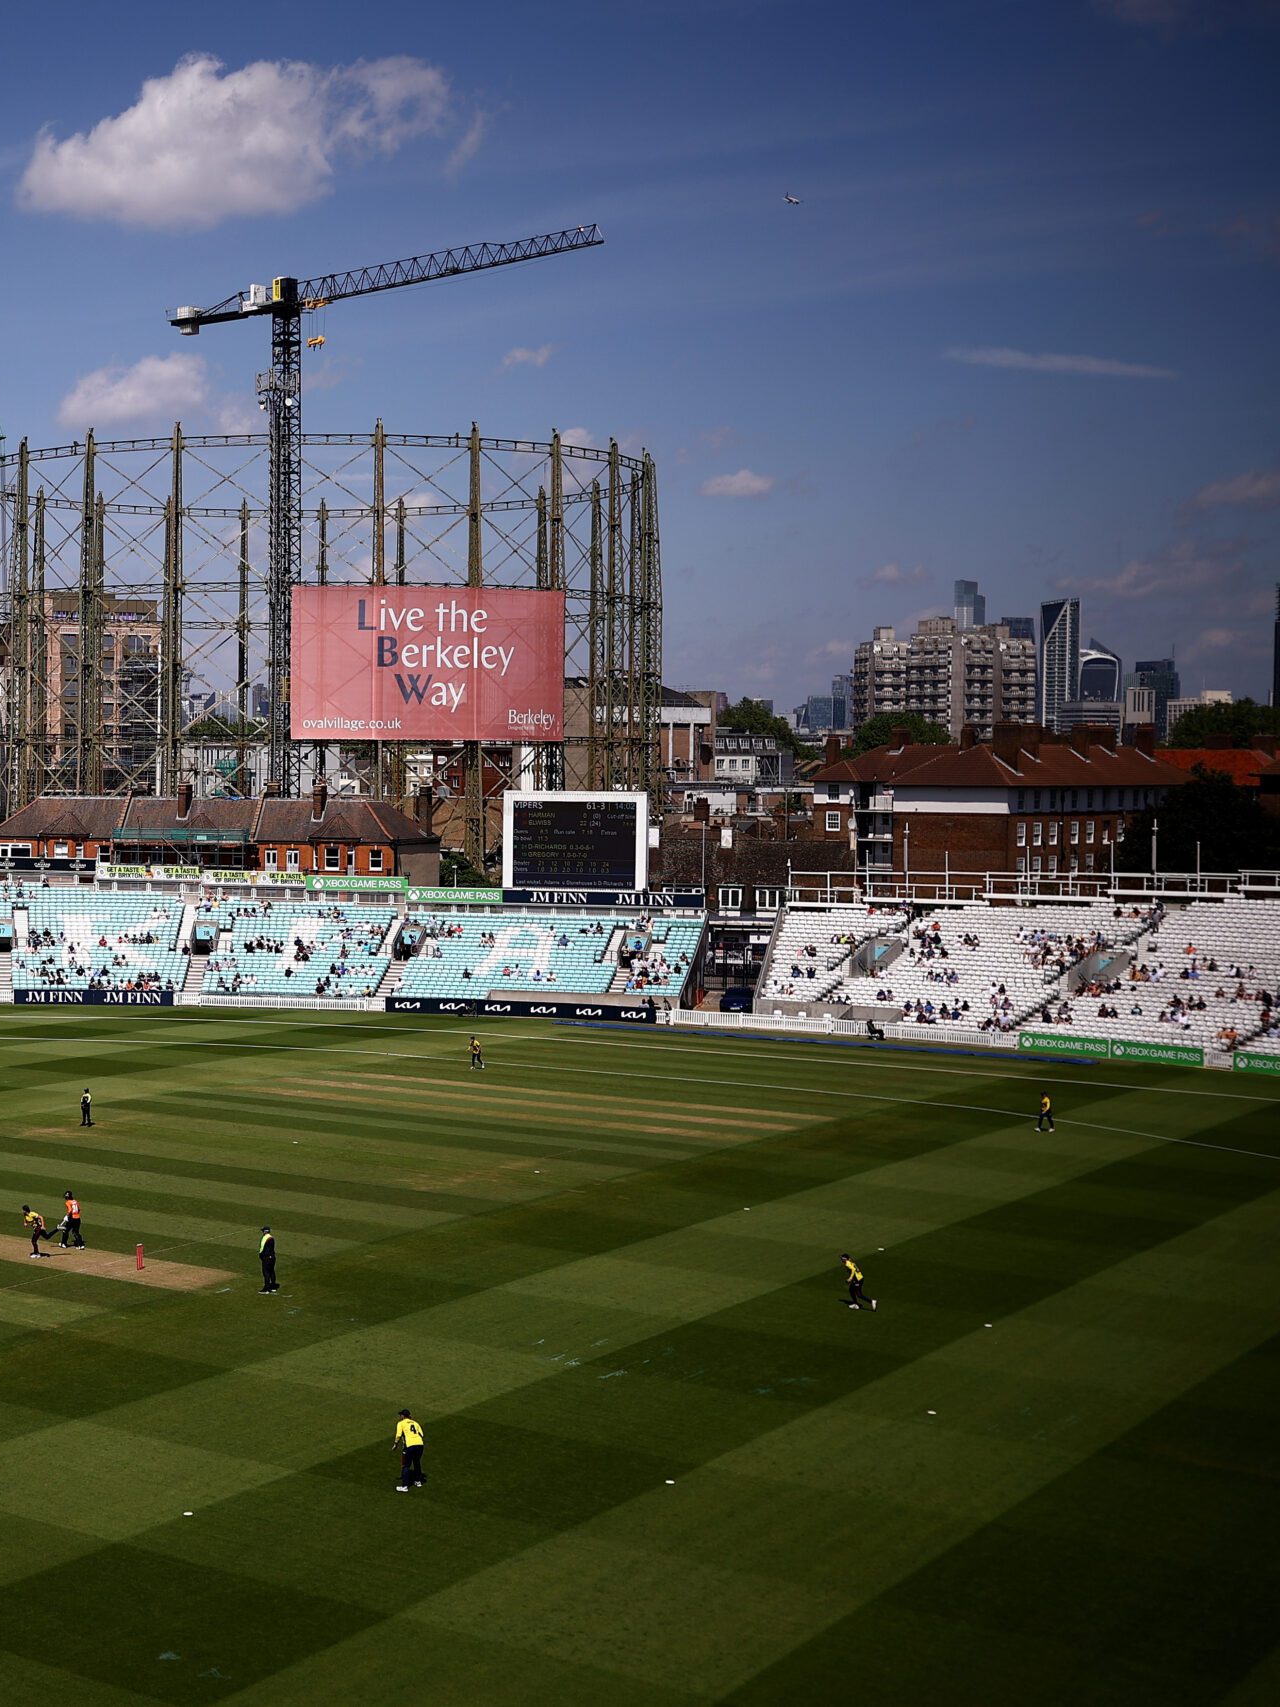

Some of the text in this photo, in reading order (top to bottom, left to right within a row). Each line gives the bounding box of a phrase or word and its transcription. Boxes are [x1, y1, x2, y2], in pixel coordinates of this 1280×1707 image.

[358, 599, 488, 632] Live the
[377, 636, 515, 676] Berkeley
[394, 673, 466, 712] Way
[303, 716, 402, 730] ovalvillage.co.uk
[508, 708, 555, 730] Berkeley
[514, 801, 636, 810] VIPERS 61-3 14:02
[325, 879, 402, 889] XBOX GAME PASS
[421, 890, 500, 900] XBOX GAME PASS
[530, 892, 588, 903] JM FINN
[615, 893, 636, 905] JM
[25, 991, 83, 1003] JM FINN
[104, 992, 162, 1004] JM FINN
[395, 1001, 421, 1009] KIA
[485, 1003, 511, 1012] KIA
[530, 1005, 557, 1014] KIA
[576, 1007, 602, 1016] KIA
[621, 1010, 646, 1019] KIA
[1033, 1038, 1108, 1053] XBOX GAME PASS
[1125, 1045, 1201, 1062] XBOX GAME PASS
[1249, 1058, 1273, 1069] XBOX
[410, 1424, 417, 1435] 4
